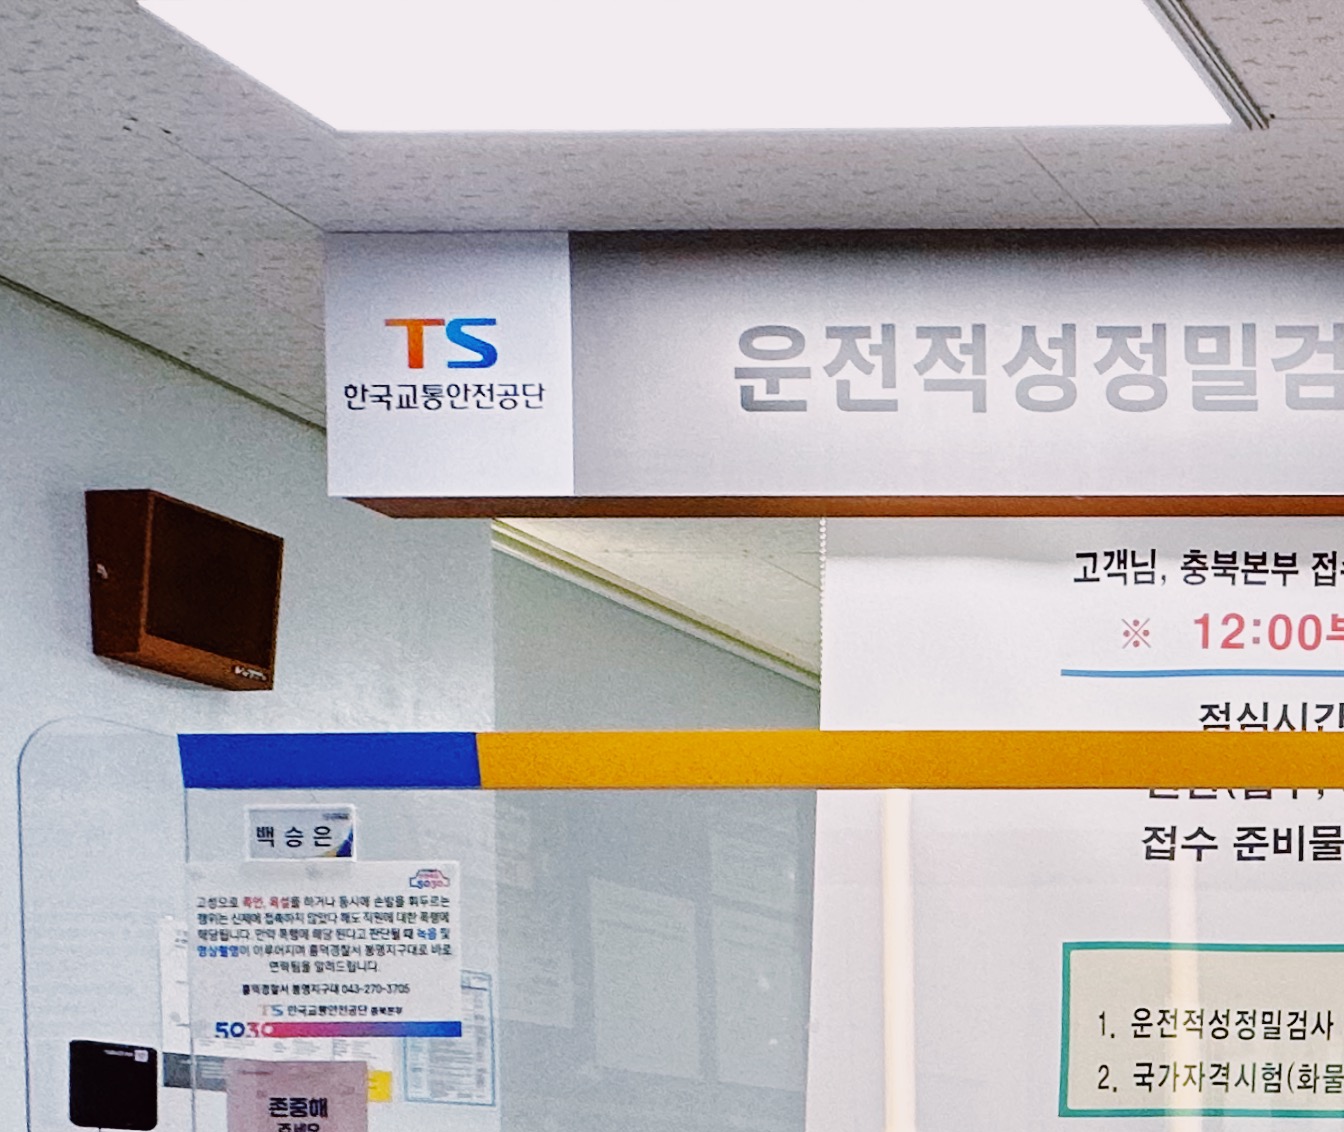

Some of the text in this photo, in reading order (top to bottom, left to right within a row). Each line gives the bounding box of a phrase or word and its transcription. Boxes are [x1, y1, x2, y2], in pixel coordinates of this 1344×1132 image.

[385, 318, 497, 369] TS
[344, 380, 545, 410] 한국교통안전공단
[1073, 548, 1167, 587] 고객님,
[1180, 549, 1300, 588] 충북본부
[1141, 824, 1219, 863] 접수
[1098, 1010, 1116, 1039] 1.
[1131, 1008, 1334, 1041] 운전적성정밀검사
[1097, 1064, 1118, 1093] 2.
